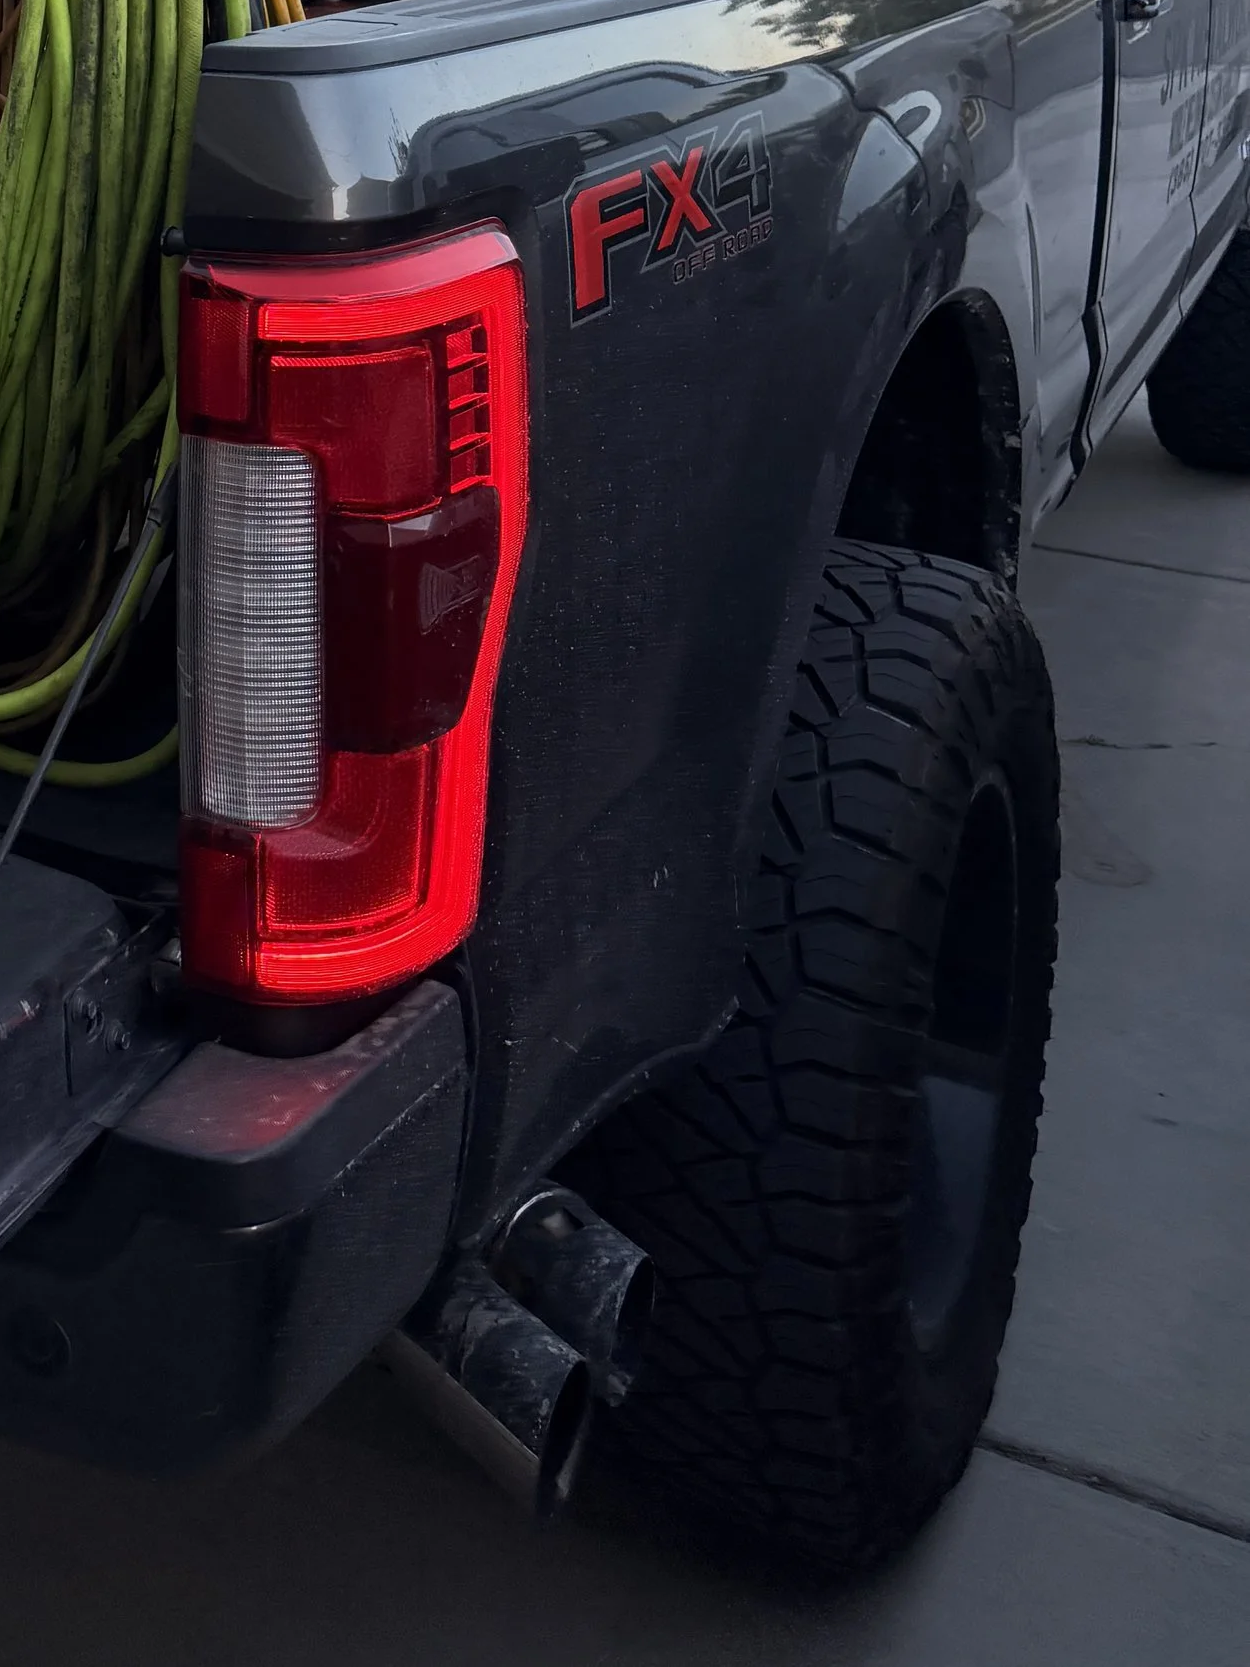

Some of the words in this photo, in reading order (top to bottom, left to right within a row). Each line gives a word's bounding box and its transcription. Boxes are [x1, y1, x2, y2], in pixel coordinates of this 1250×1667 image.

[563, 110, 774, 328] FX4
[672, 246, 717, 285] OFF
[722, 215, 775, 262] ROAD
